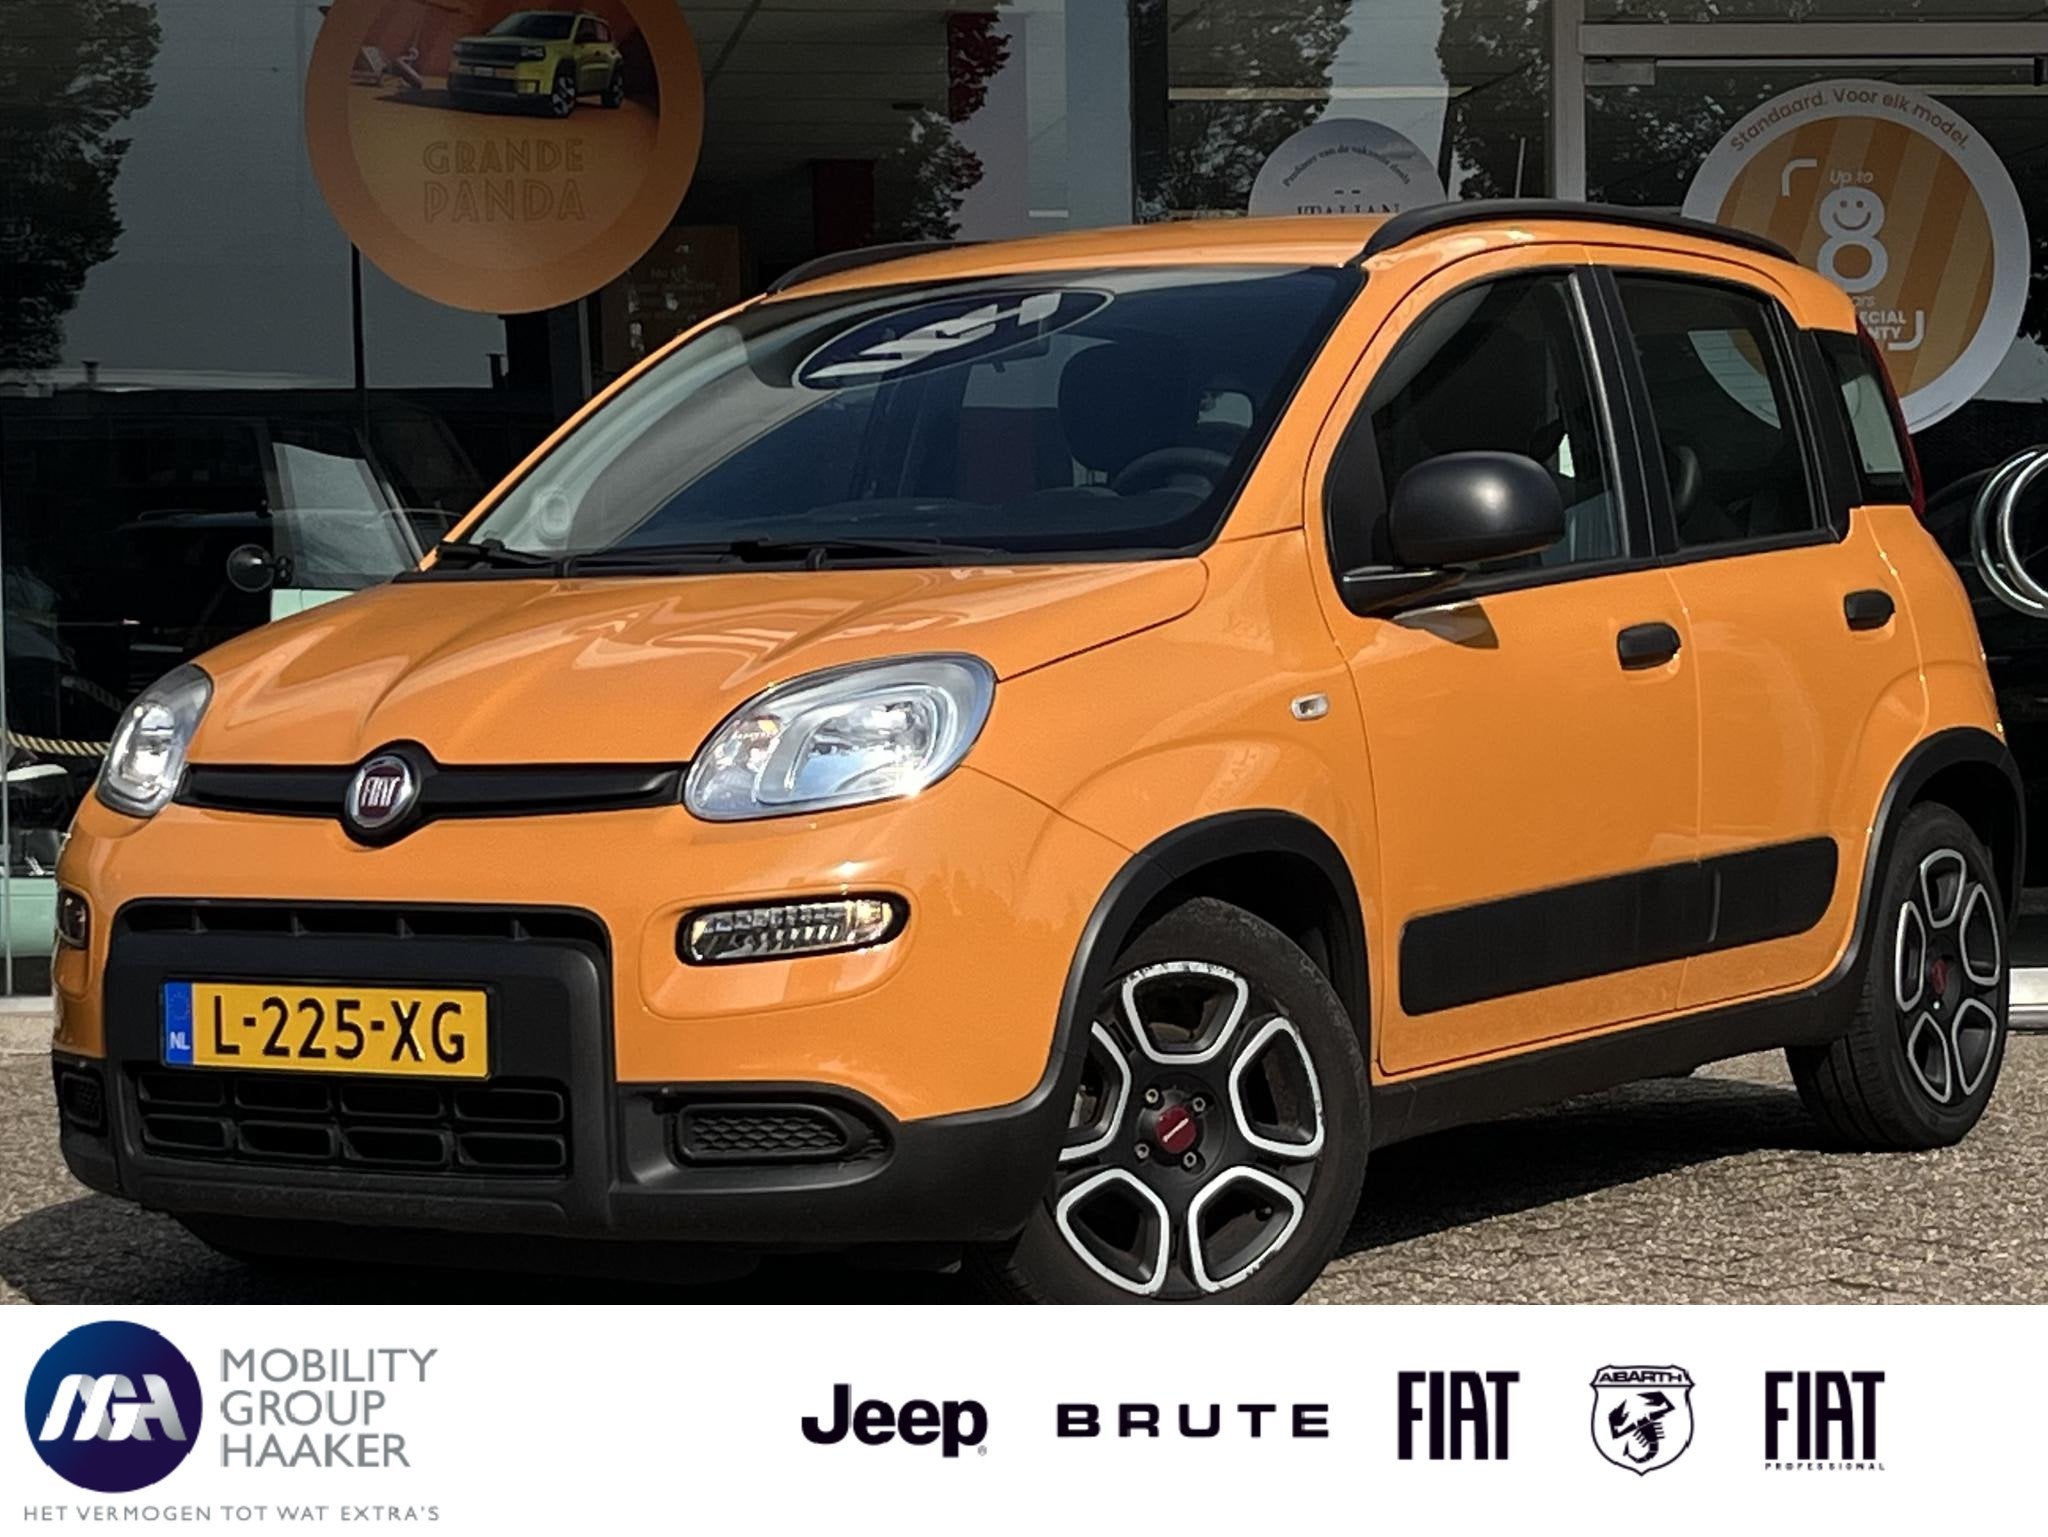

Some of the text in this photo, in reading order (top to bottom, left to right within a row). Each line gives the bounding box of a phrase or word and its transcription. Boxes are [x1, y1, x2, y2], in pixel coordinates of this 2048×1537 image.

[1731, 88, 1969, 151] Standaard. Voor elk model.
[423, 139, 583, 174] GRANDE
[1829, 170, 1874, 185] Up to
[423, 179, 585, 222] PANDA
[1817, 186, 1889, 293] 8
[360, 775, 401, 807] FIAT
[169, 1031, 191, 1050] NL
[213, 995, 466, 1064] L-225-XG
